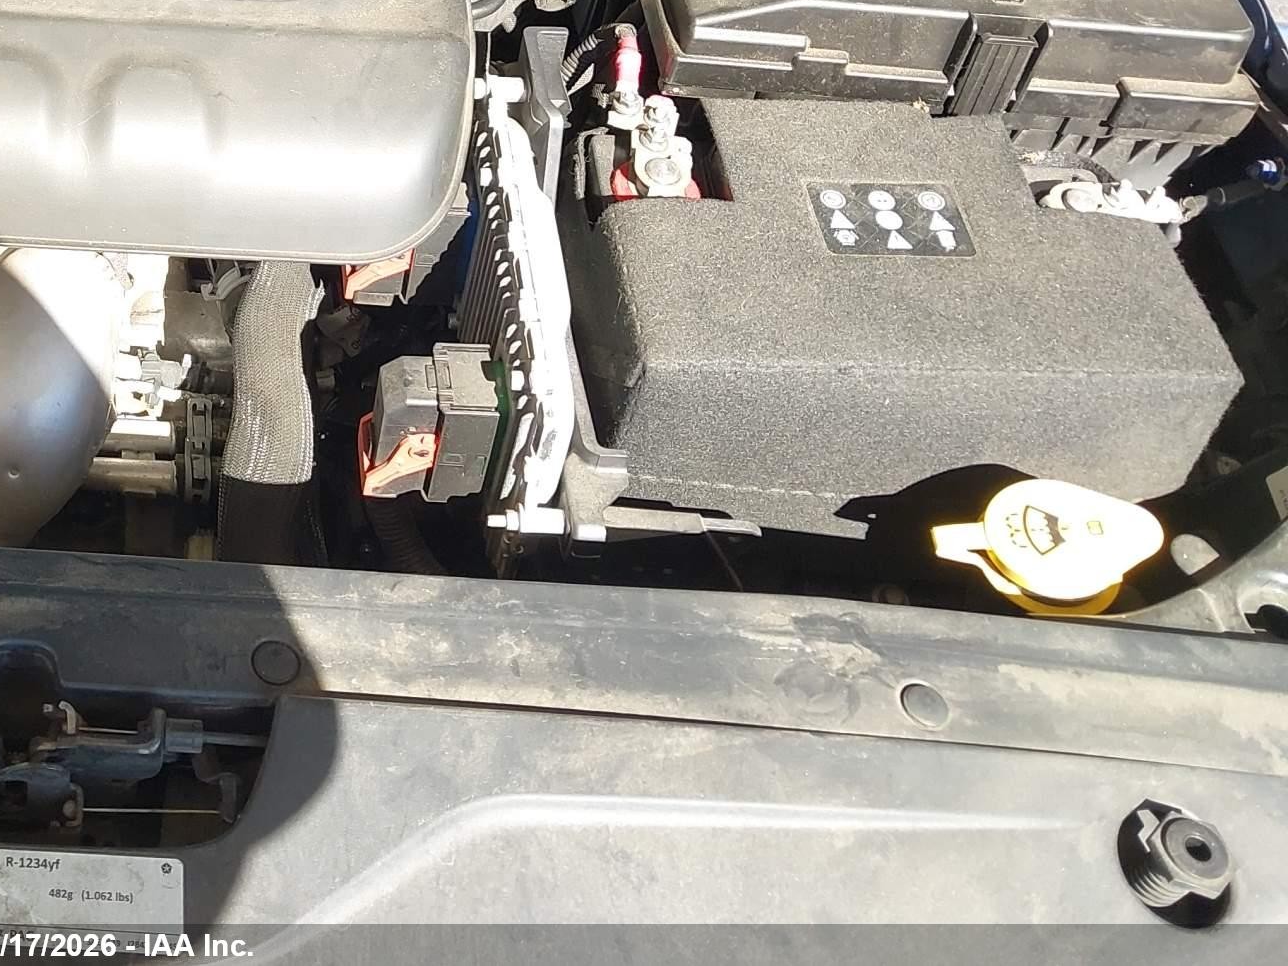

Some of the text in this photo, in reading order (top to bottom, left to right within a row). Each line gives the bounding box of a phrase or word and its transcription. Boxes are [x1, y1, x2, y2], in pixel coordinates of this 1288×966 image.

[5, 856, 61, 872] R-1234yf
[48, 888, 134, 904] 482g (1.062 lbs)
